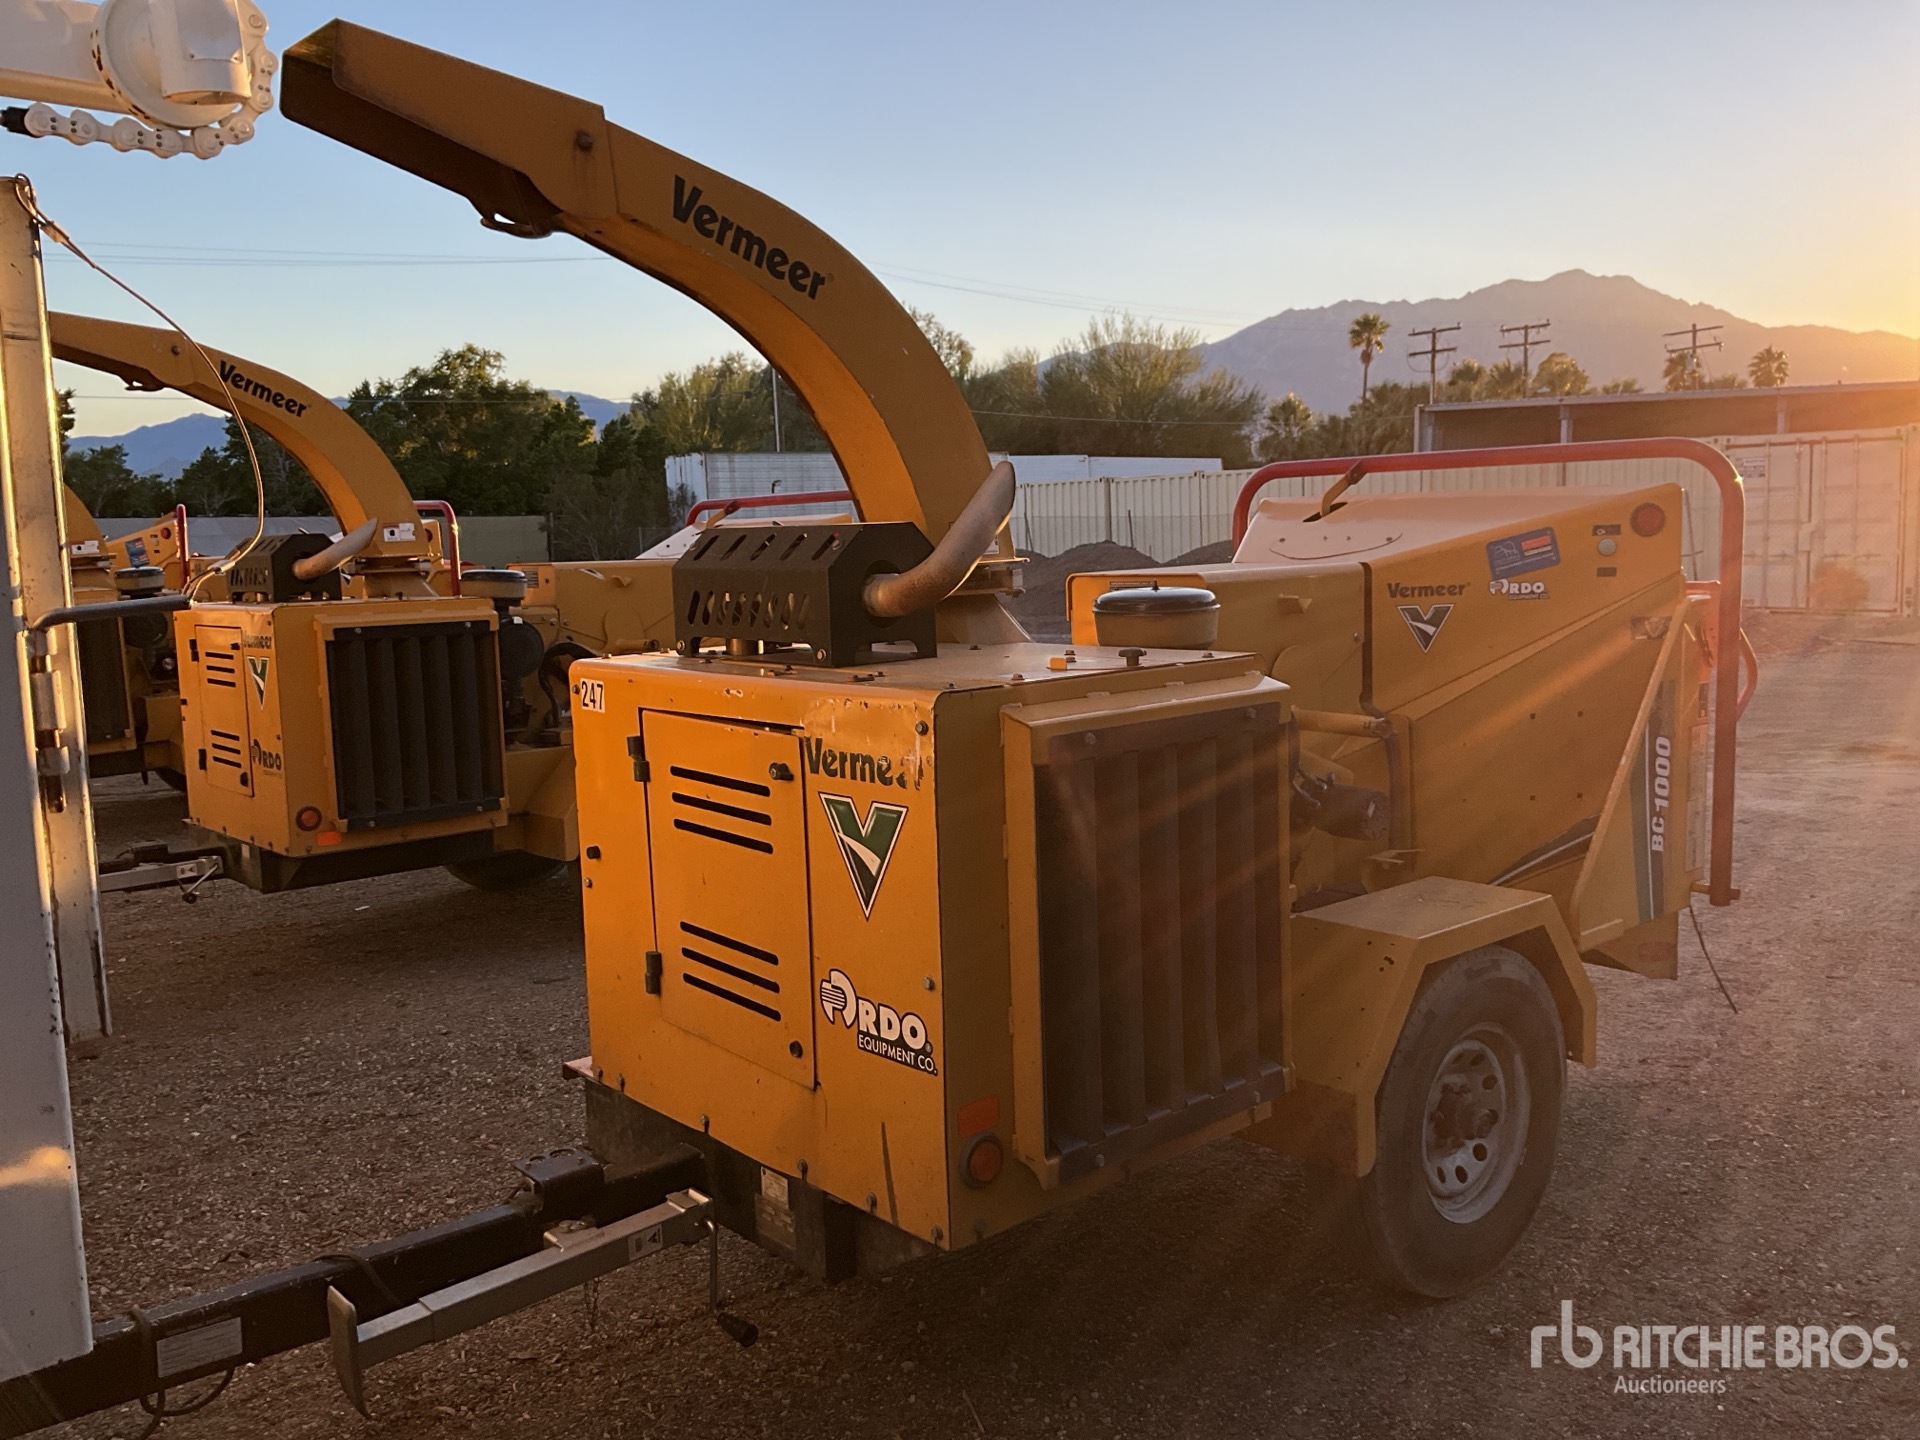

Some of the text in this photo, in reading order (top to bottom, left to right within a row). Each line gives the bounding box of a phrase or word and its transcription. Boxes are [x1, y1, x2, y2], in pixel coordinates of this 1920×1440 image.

[673, 174, 826, 300] Vermeer
[220, 359, 307, 417] Vermeer
[1386, 582, 1466, 599] Vermeer
[581, 680, 604, 710] 247
[1652, 736, 1671, 851] BC 1000
[858, 1034, 937, 1075] EQUIPMENT CO.
